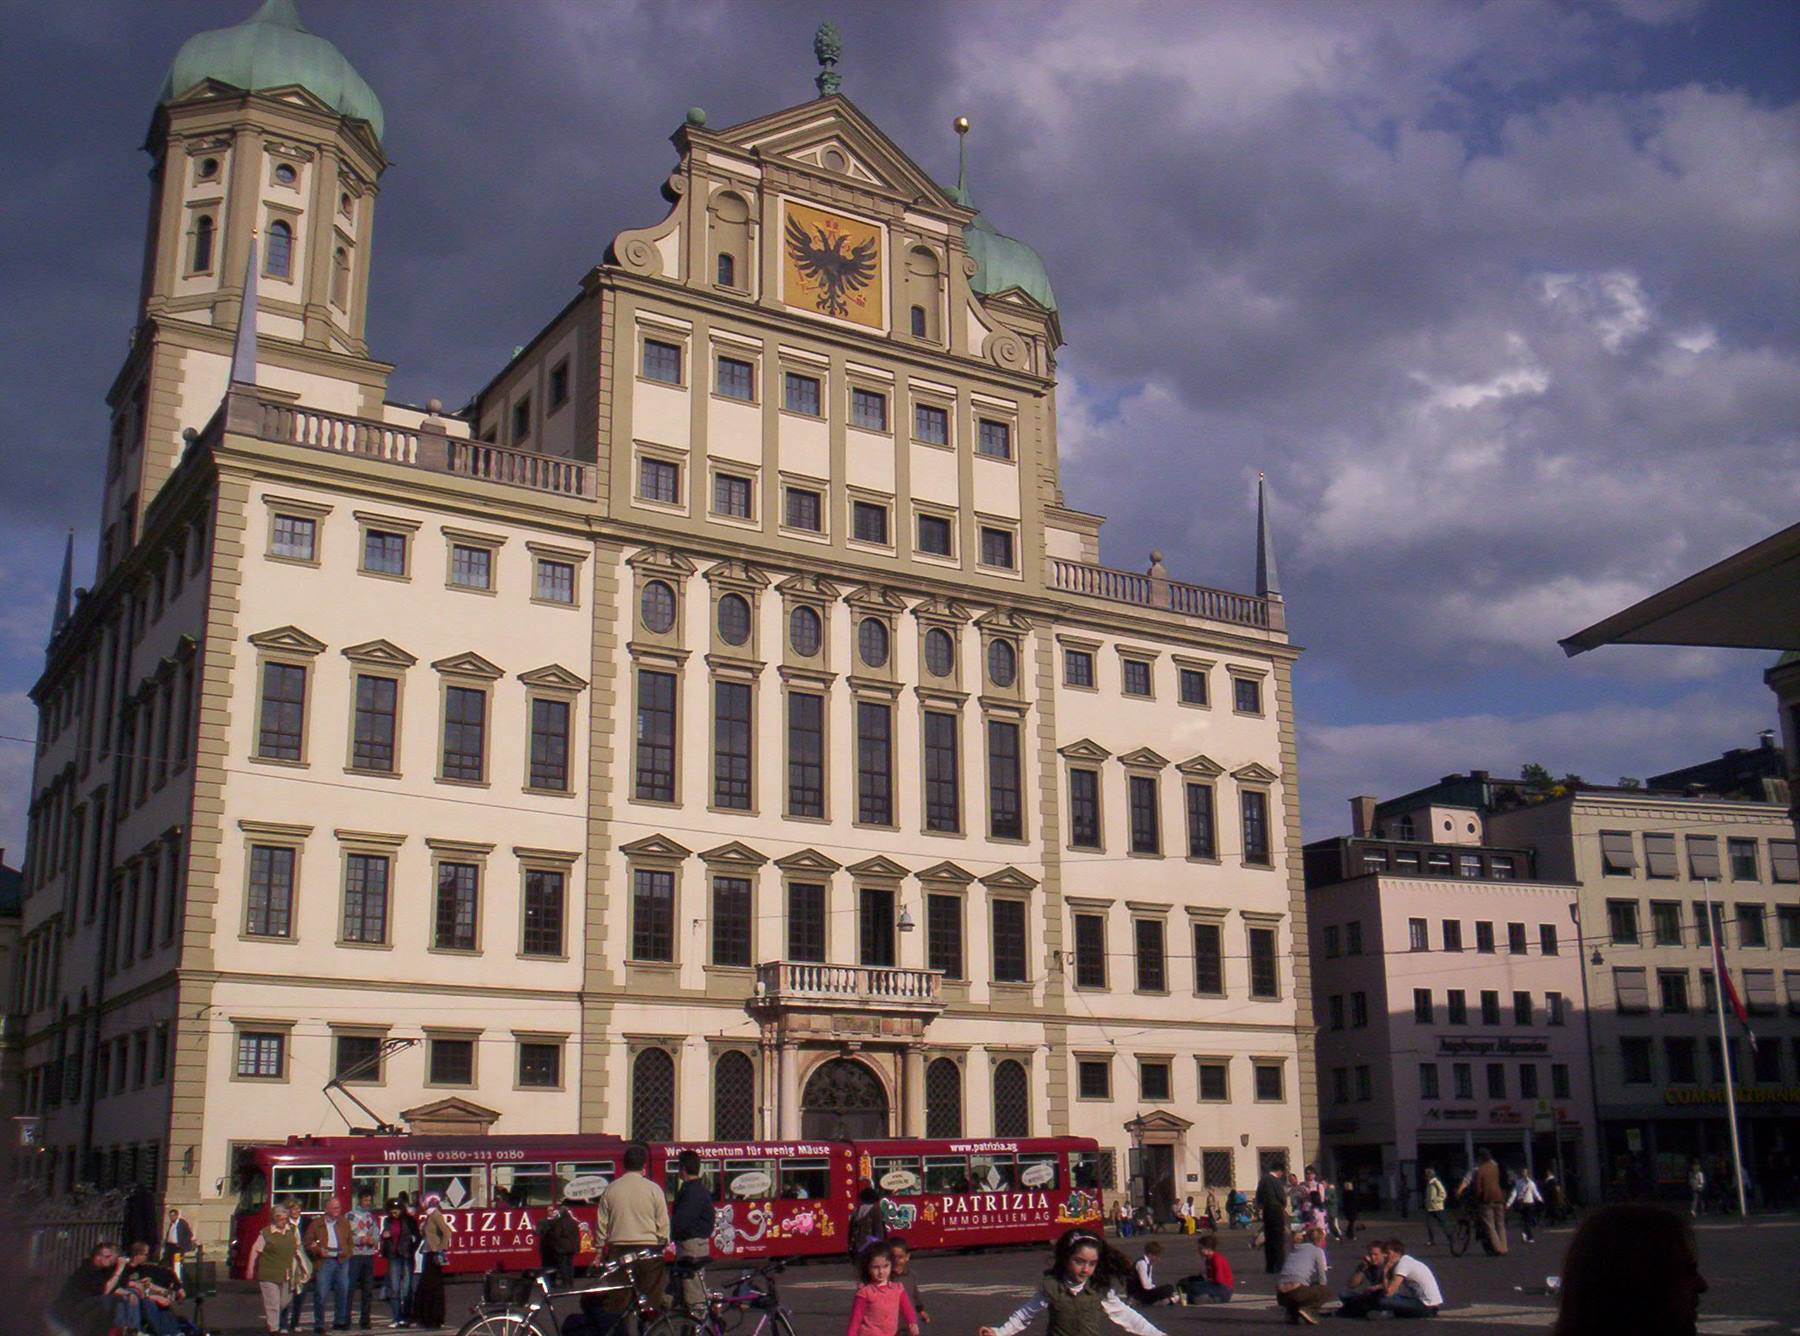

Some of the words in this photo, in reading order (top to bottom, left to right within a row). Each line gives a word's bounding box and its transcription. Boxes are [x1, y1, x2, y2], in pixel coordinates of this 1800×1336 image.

[664, 1146, 743, 1158] Woeigentum
[746, 1145, 761, 1156] für
[764, 1145, 795, 1157] wenig
[797, 1144, 830, 1155] Mäuse
[949, 1141, 1018, 1153] www.patrizia.ag
[384, 1149, 432, 1161] Infoline
[496, 1150, 525, 1160] 0180
[942, 1192, 1049, 1214] PATRIZIA
[377, 1211, 534, 1235] RIZIA
[942, 1212, 1027, 1226] IMMOBILIEN
[1034, 1211, 1050, 1221] AG
[512, 1234, 535, 1246] AG
